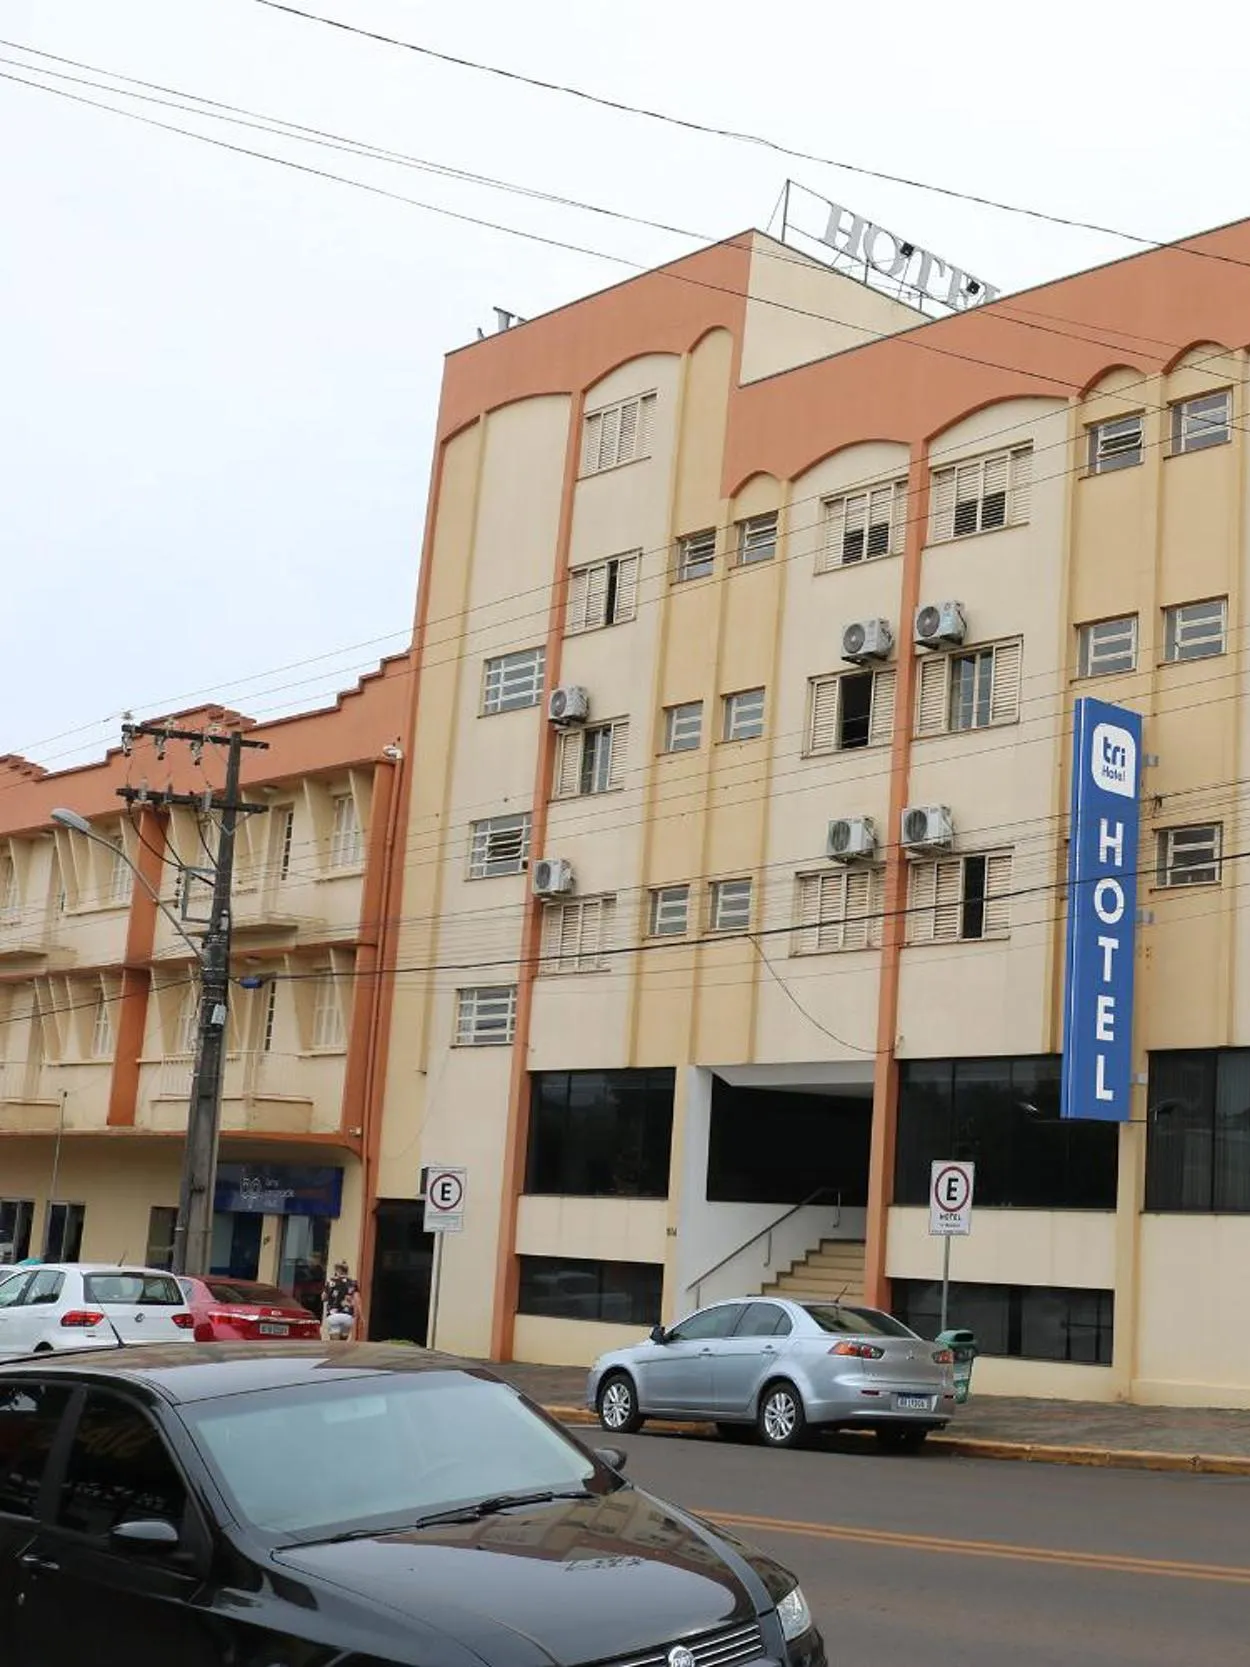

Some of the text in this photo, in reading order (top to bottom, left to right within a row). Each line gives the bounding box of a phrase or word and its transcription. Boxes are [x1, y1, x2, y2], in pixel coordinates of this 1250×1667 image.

[1103, 736, 1126, 767] tri
[1102, 765, 1126, 781] Hotel
[1093, 817, 1125, 1101] HOTEL
[440, 1182, 452, 1201] E
[946, 1177, 959, 1201] E
